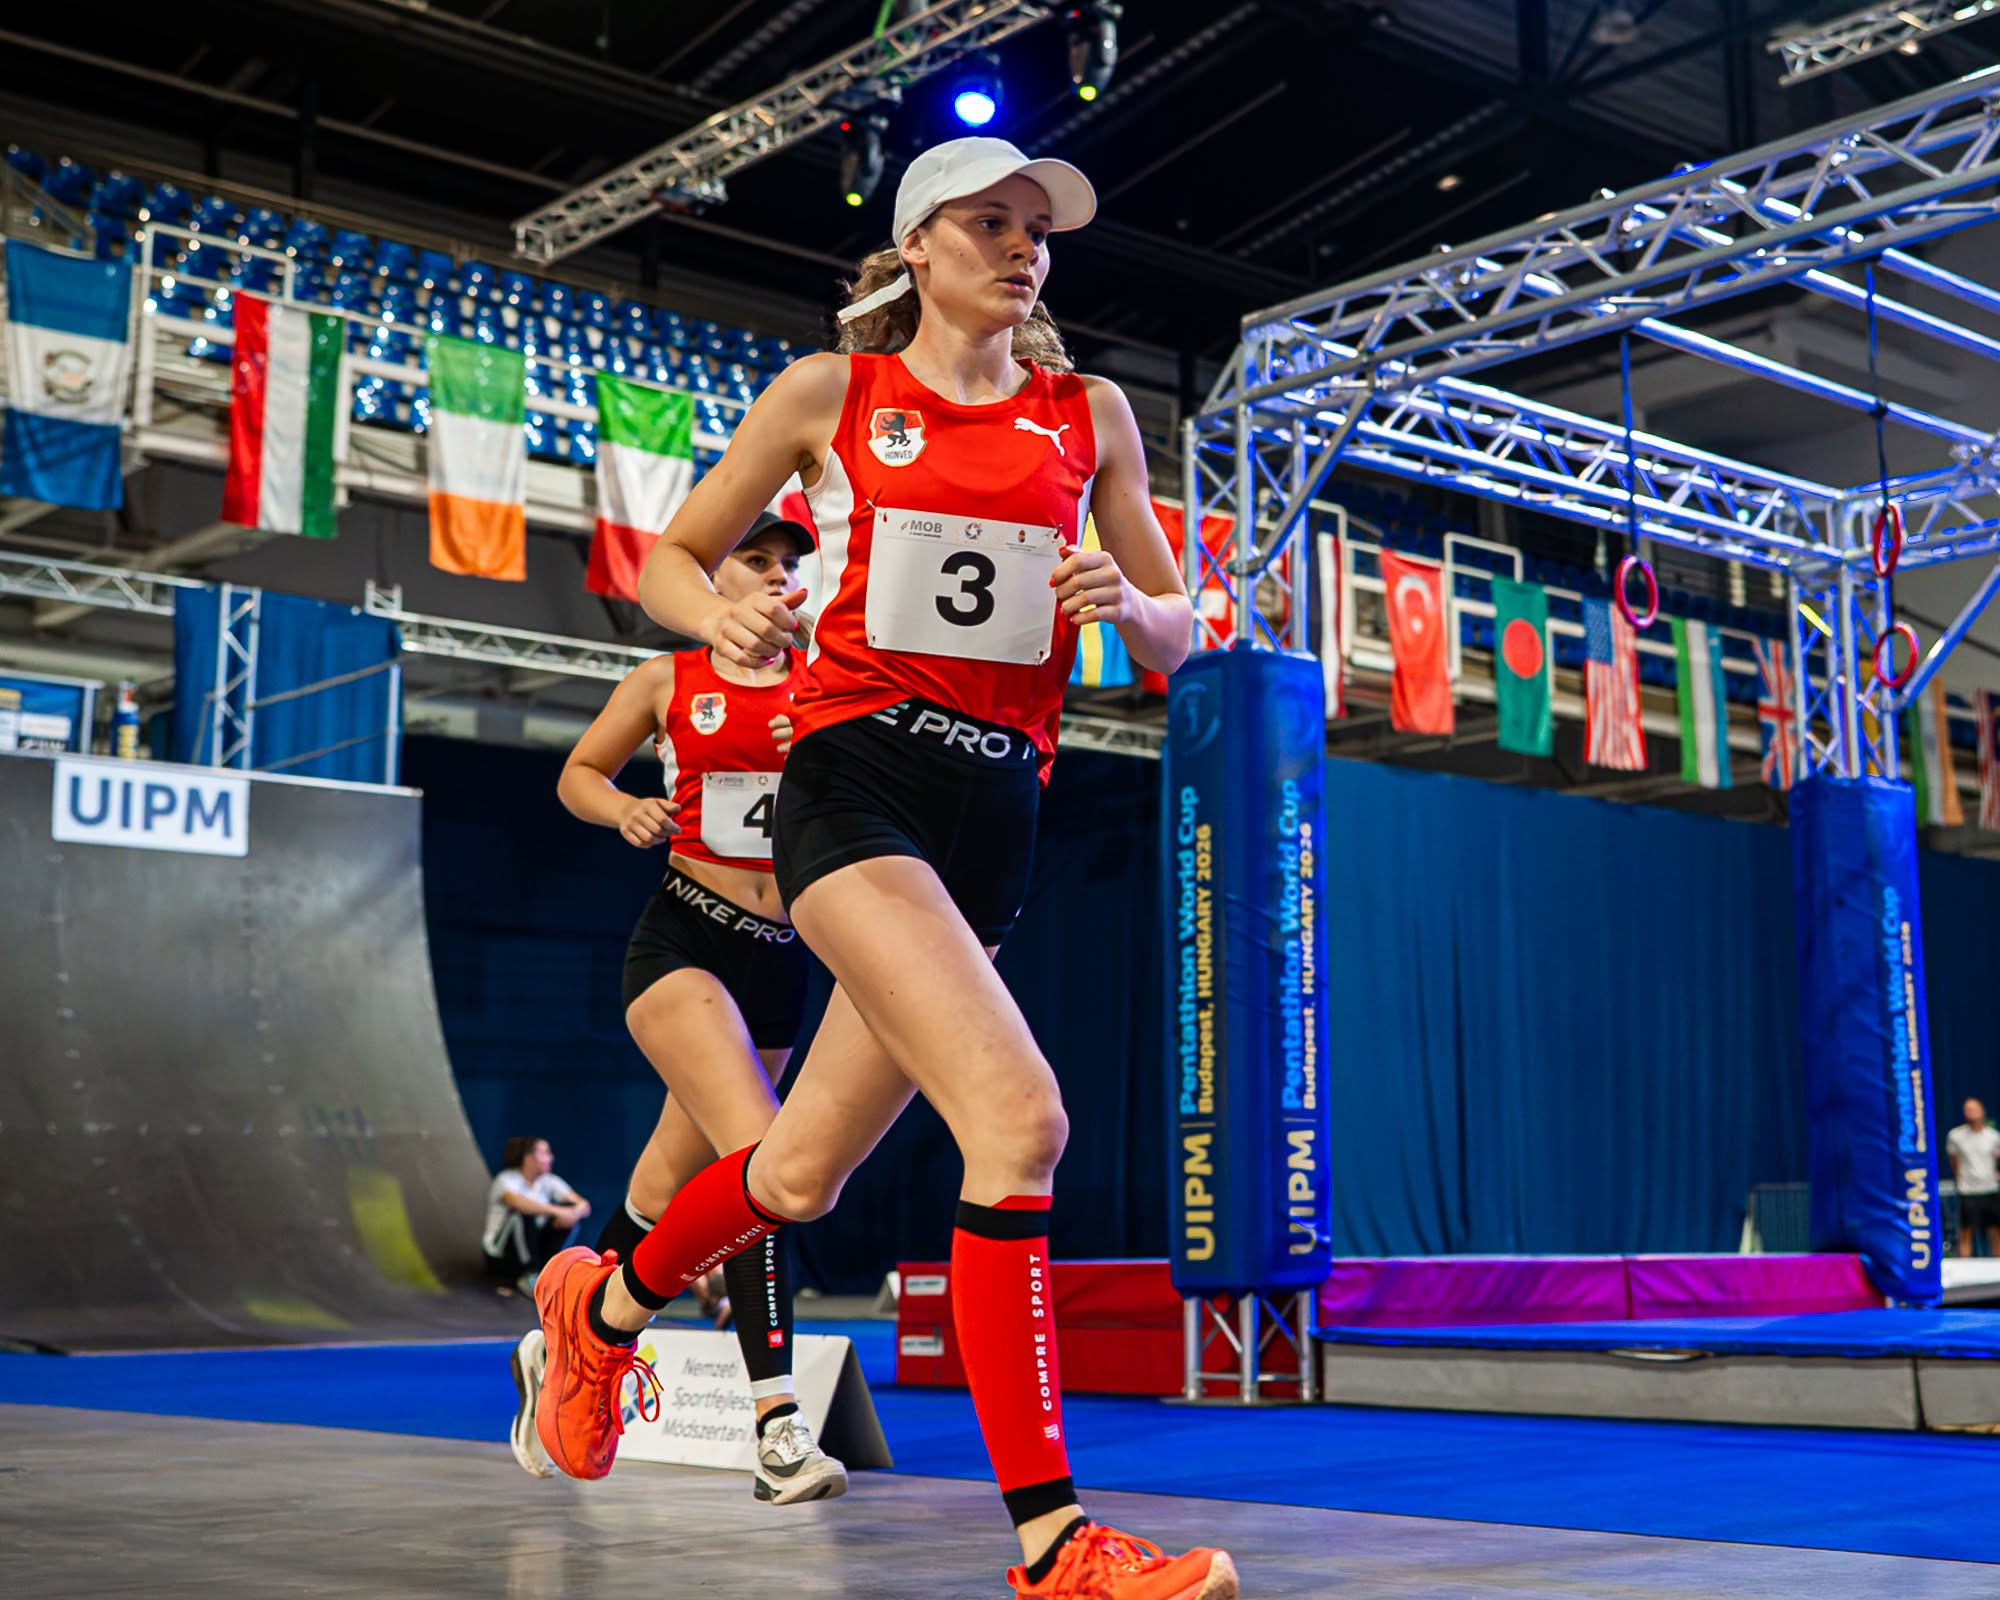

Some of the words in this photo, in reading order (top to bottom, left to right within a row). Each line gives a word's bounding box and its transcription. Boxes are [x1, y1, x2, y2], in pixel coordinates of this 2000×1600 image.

[909, 519, 943, 534] MOB
[935, 550, 997, 627] 3
[909, 709, 1011, 758] PRO
[69, 775, 233, 838] UIPM
[743, 792, 775, 838] 4
[1177, 786, 1199, 846] Cup
[1278, 778, 1302, 838] Cup
[666, 877, 736, 924] NIKE
[734, 916, 796, 943] PRO
[1177, 850, 1197, 941] World
[1278, 841, 1301, 934] World
[1882, 886, 1901, 936] Cup
[1196, 886, 1213, 998] HUNGARY
[1301, 884, 1315, 995] HUNGARY
[1178, 945, 1197, 1114] Pentathlon
[1279, 940, 1302, 1109] Pentathlon
[1183, 1132, 1216, 1261] UIPM
[1286, 1129, 1317, 1256] UIPM
[1904, 1168, 1931, 1270] UIPM
[695, 1245, 735, 1272] COMPRE
[735, 1224, 766, 1245] SPORT
[765, 1234, 775, 1273] SPORT
[767, 1281, 779, 1327] COMPRE
[1030, 1254, 1045, 1318] SPORT
[1035, 1333, 1053, 1411] COMPRE
